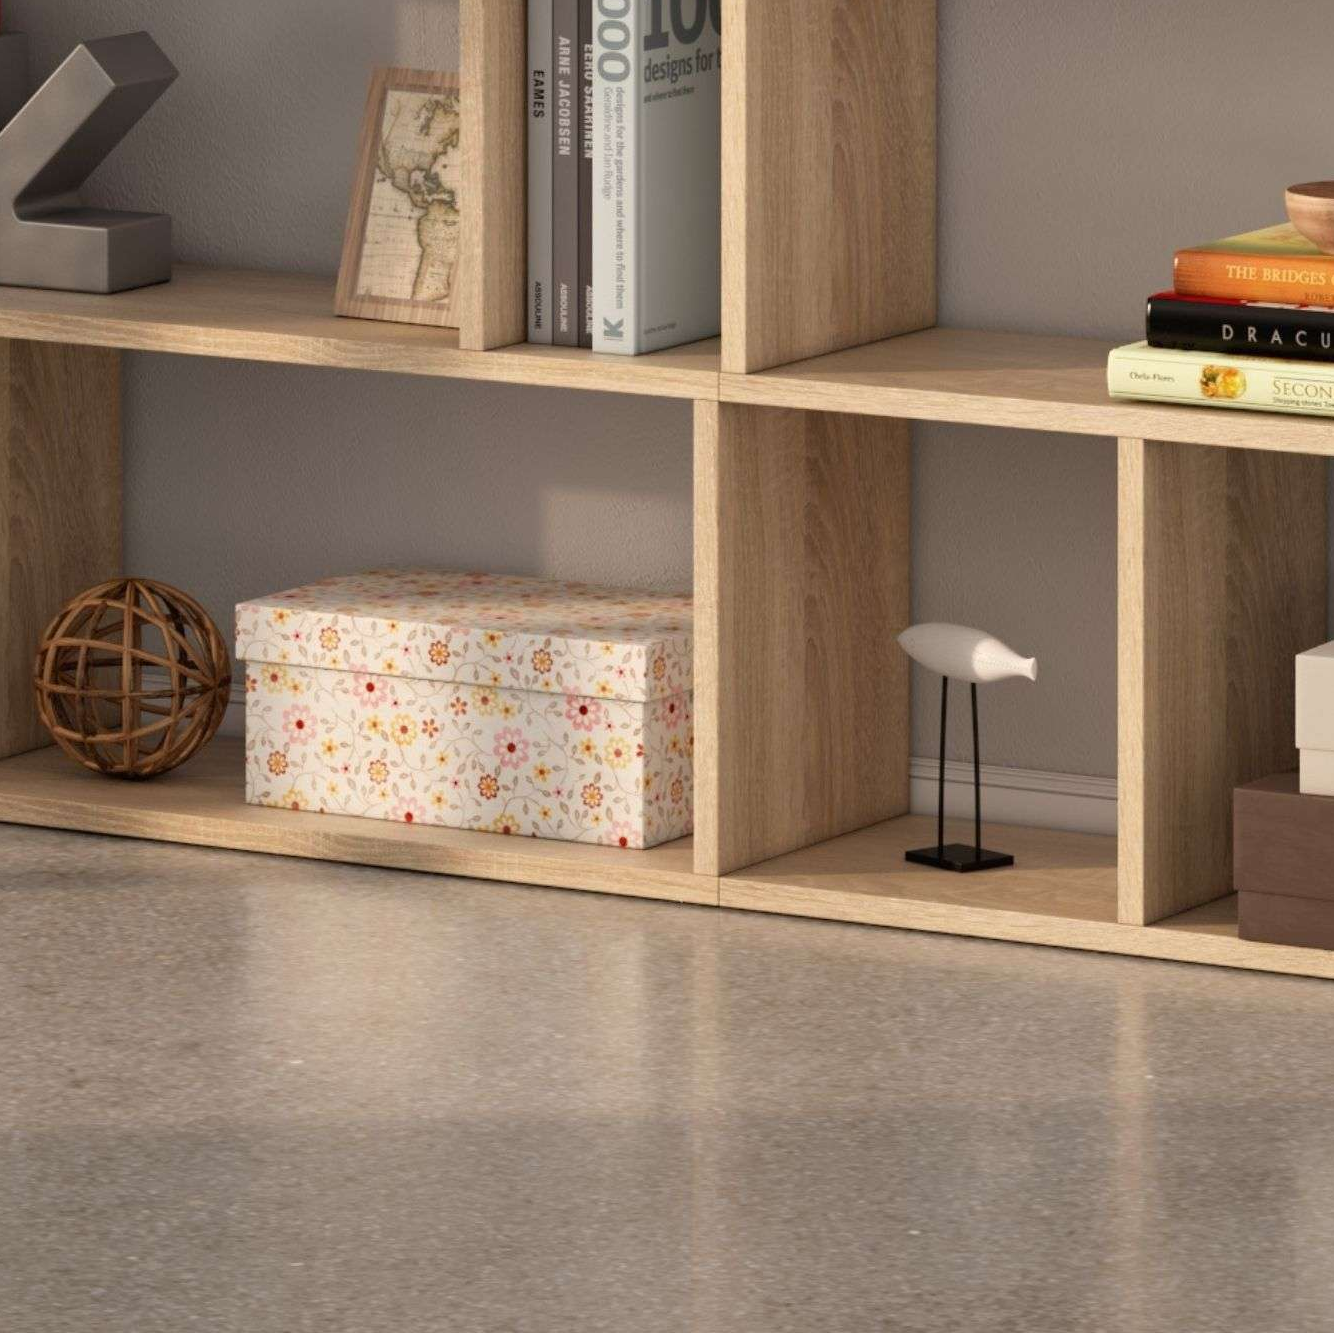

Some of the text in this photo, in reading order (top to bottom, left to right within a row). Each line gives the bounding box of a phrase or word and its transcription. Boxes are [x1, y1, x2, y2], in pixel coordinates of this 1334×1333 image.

[644, 54, 693, 85] designs
[695, 49, 713, 73] for
[533, 69, 545, 119] EAMES
[557, 36, 571, 156] ARNE JACOBSEN
[615, 87, 628, 309] designs for the gardens and where to find them
[1225, 265, 1258, 281] THE
[1262, 269, 1327, 286] BRIDGES
